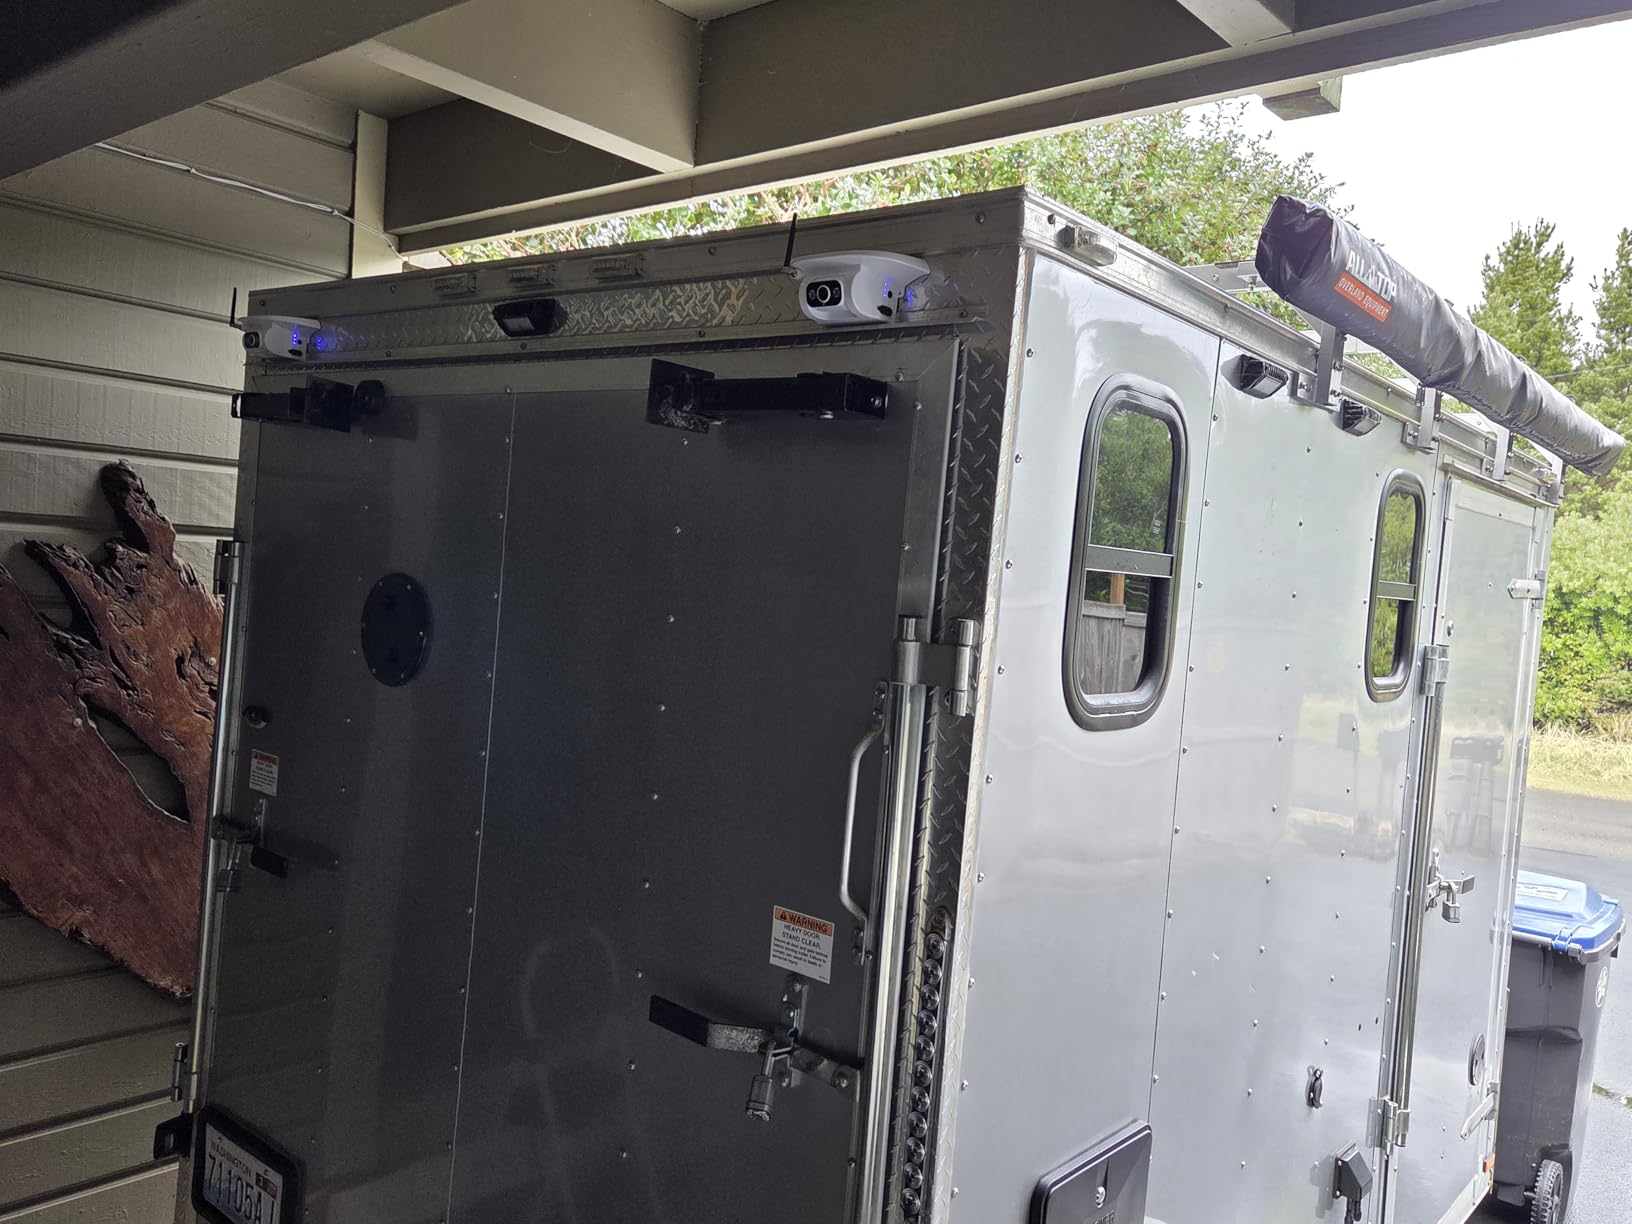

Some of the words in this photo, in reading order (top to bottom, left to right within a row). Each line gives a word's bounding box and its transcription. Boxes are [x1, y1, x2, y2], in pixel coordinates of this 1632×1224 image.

[1339, 277, 1365, 301] OVERLAND
[1362, 295, 1389, 318] EQUIPMENT
[784, 924, 802, 934] HEAVY
[790, 911, 828, 933] WARNING
[782, 931, 801, 942] STAND
[210, 1139, 252, 1178] WASHINGTON
